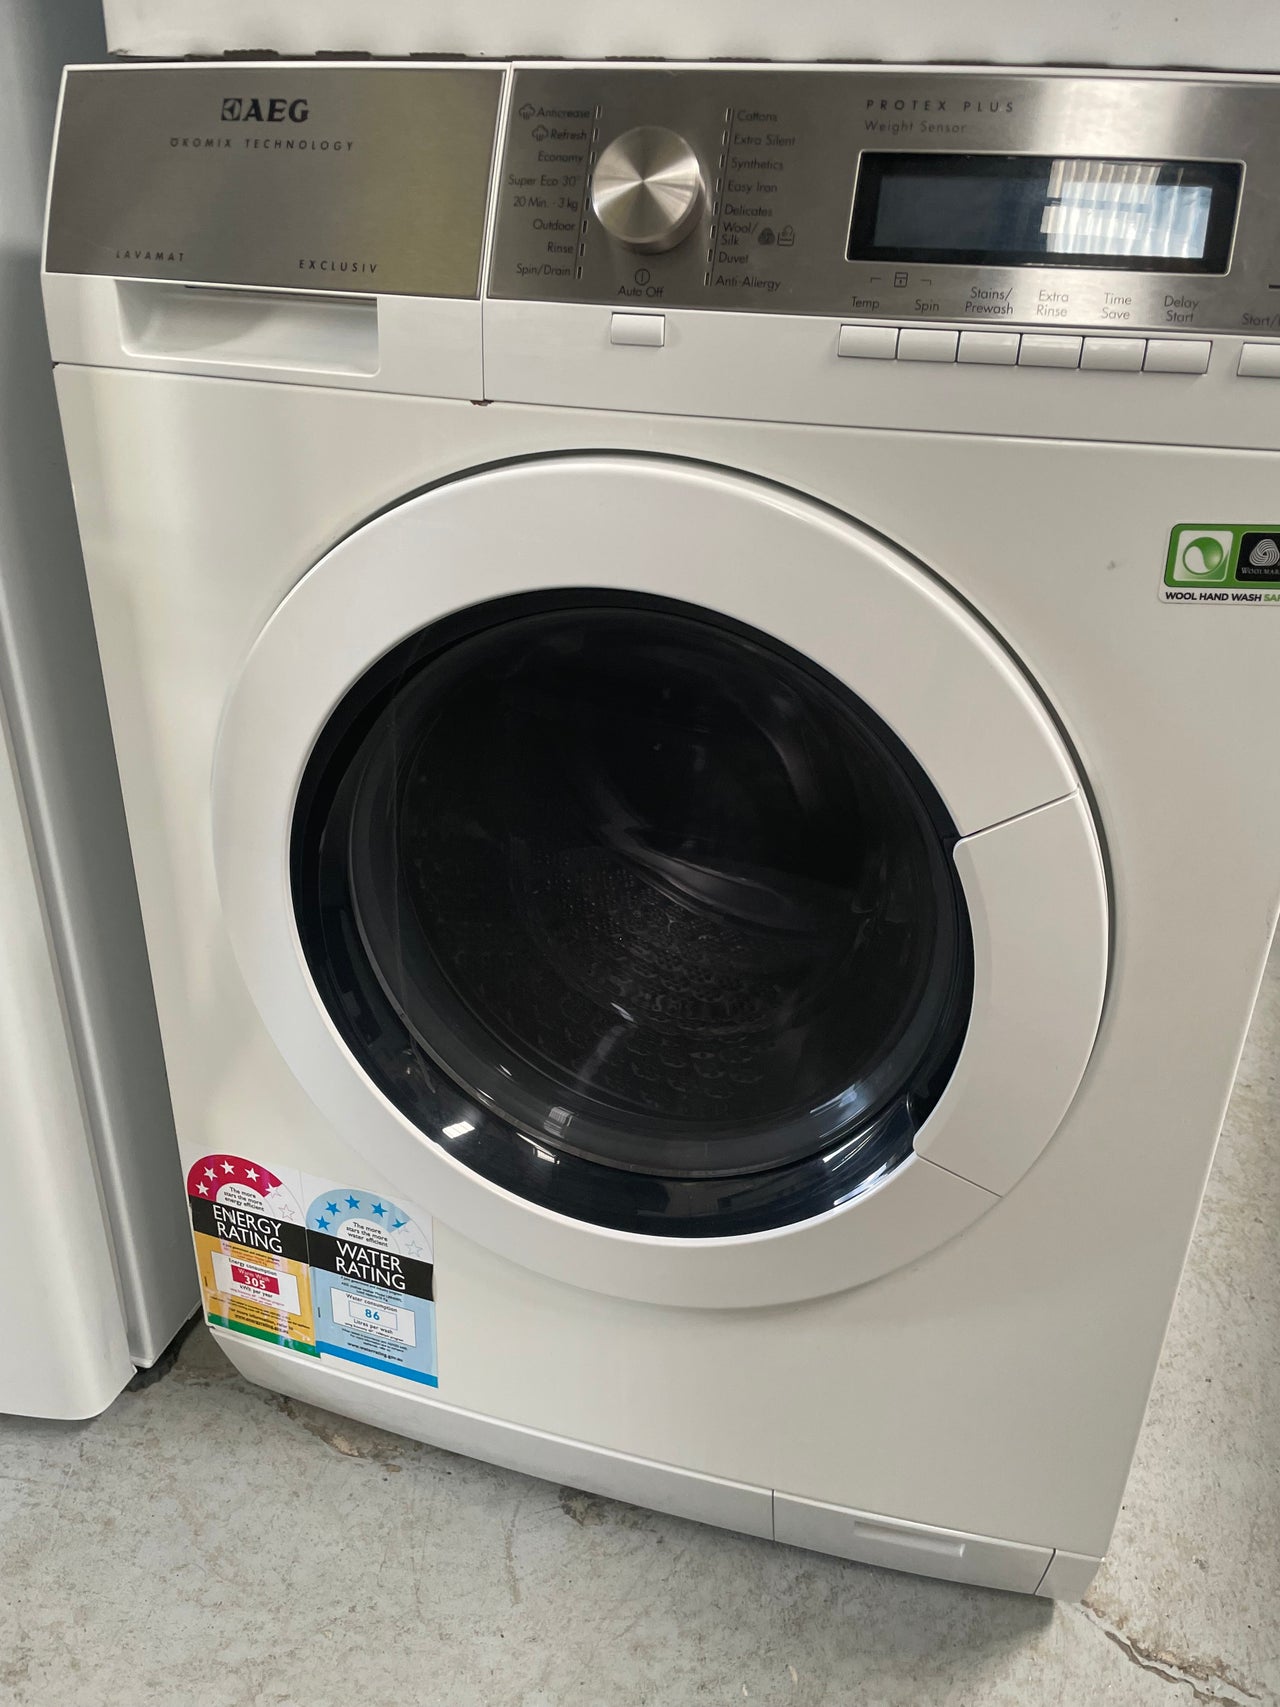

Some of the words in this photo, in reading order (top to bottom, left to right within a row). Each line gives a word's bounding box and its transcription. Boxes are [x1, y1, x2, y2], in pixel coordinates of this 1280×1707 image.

[242, 98, 309, 123] AEG
[865, 99, 947, 111] PROTEX
[963, 101, 1014, 113] PLUS
[737, 110, 778, 122] Cottons
[550, 129, 587, 140] Refresh
[864, 120, 914, 135] Weight
[920, 120, 967, 134] Sensor
[245, 138, 354, 151] TECHNOLOGY
[733, 134, 762, 145] Extra
[765, 134, 796, 146] Silent
[537, 151, 584, 165] Economy
[731, 157, 784, 171] Synthetics
[508, 174, 536, 188] Super
[540, 174, 559, 187] Eco
[727, 180, 753, 194] Easy
[756, 181, 778, 193] Iron
[513, 195, 526, 208] 20
[558, 197, 565, 208] 3
[567, 198, 579, 212] kg
[725, 203, 773, 217] Delicates
[533, 218, 576, 231] Outdoor
[722, 221, 759, 234] Wool/
[721, 234, 740, 246] Silk
[547, 241, 574, 254] Rinse
[116, 250, 185, 262] LAVAMAT
[718, 251, 749, 263] Duvet
[299, 259, 378, 274] EXCLUSIV
[516, 263, 571, 277] Spin/Drain
[616, 284, 643, 297] Auto
[645, 286, 665, 298] Off
[970, 286, 1013, 301] Stains/
[1038, 289, 1070, 303] Extra
[851, 296, 880, 311] Temp
[914, 299, 940, 313] Spin
[1104, 292, 1132, 306] Time
[1164, 295, 1200, 309] Delay
[965, 301, 1014, 315] Prewash
[1036, 303, 1068, 317] Rinse
[1101, 307, 1131, 320] Save
[1165, 310, 1195, 323] Start
[1241, 312, 1280, 328] Start/
[1165, 591, 1198, 601] WOOL
[1199, 592, 1229, 601] HAND
[1231, 593, 1262, 602] WASH
[223, 1191, 237, 1199] stars
[248, 1198, 263, 1206] more
[230, 1186, 241, 1195] The
[241, 1191, 257, 1199] more
[224, 1197, 242, 1206] energy
[213, 1204, 282, 1237] ENERGY
[346, 1226, 360, 1234] stars
[372, 1233, 388, 1242] more
[352, 1221, 365, 1230] The
[365, 1226, 382, 1235] more
[217, 1221, 283, 1253] RATING
[347, 1232, 364, 1240] water
[228, 1257, 245, 1268] Energy
[336, 1240, 403, 1274] WATER
[335, 1256, 406, 1290] RATING
[244, 1275, 267, 1290] 305
[346, 1293, 363, 1303] Water
[364, 1297, 398, 1313] consumption
[365, 1308, 381, 1321] 86
[353, 1319, 369, 1327] Litres
